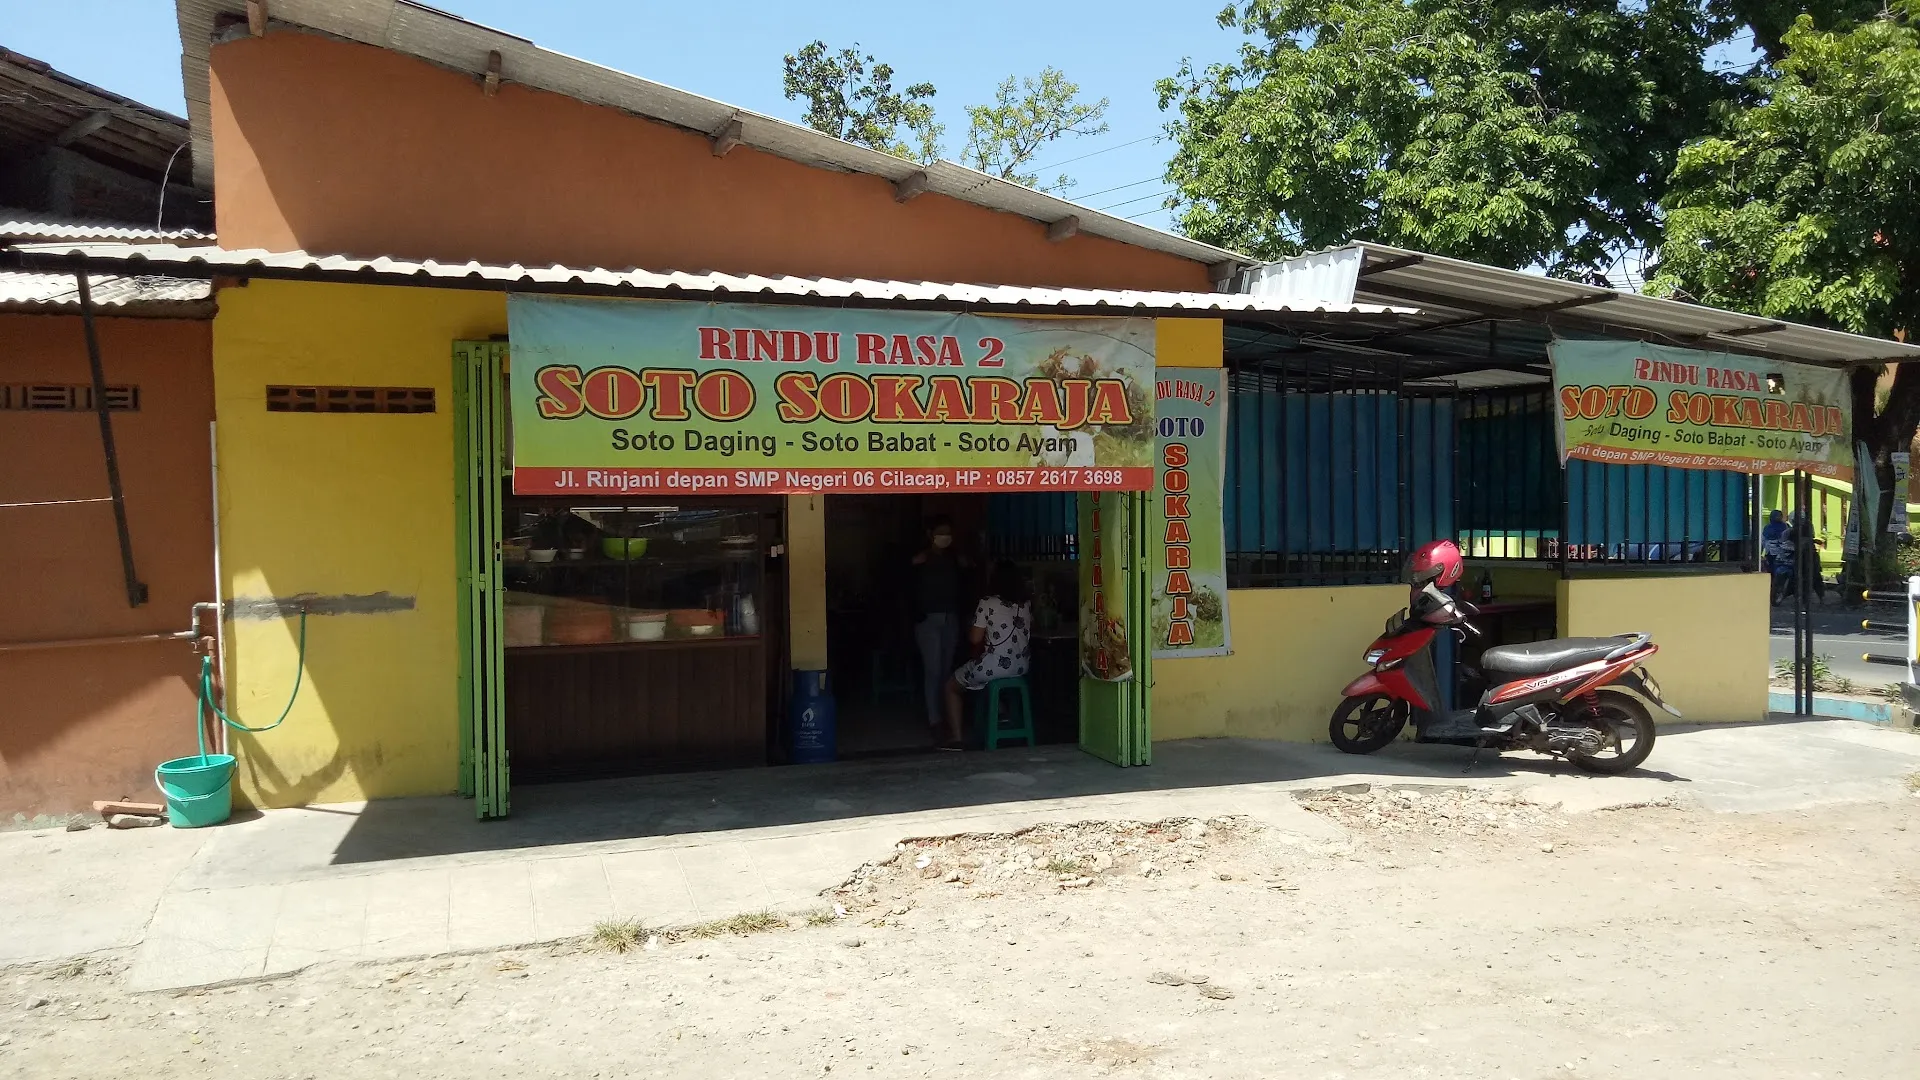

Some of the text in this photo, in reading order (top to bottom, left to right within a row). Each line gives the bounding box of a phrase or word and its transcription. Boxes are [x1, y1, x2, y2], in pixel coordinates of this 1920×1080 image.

[697, 326, 1005, 368] RINDU RASA 2
[1634, 358, 1761, 392] RINDU RASA
[535, 364, 1132, 431] SOTO SOKARAJA
[1175, 379, 1204, 403] RASA
[1203, 390, 1216, 407] 2
[1560, 384, 1843, 437] SOTO SOKARAJA
[612, 429, 674, 450] Soto
[685, 429, 776, 456] Daging
[801, 431, 859, 452] Soto
[868, 431, 937, 452] Babat
[958, 432, 1010, 452] Soto
[1016, 433, 1077, 456] Ayam
[1610, 422, 1661, 444] Daging
[1674, 429, 1704, 444] Soto
[1708, 432, 1745, 447] Babat
[1757, 435, 1787, 449] Soto
[1592, 447, 1627, 461] depan
[1630, 451, 1655, 461] SMP
[1655, 452, 1690, 465] Negeri
[1692, 456, 1705, 466] 06
[1752, 459, 1767, 470] HP
[555, 471, 579, 488] Jl.
[587, 471, 660, 491] Rinjani
[666, 471, 728, 491] depan
[734, 471, 779, 488] SMP
[786, 471, 847, 491] Negeri
[852, 471, 874, 487] 06
[880, 471, 950, 490] Cilacap,
[956, 472, 981, 486] HP
[996, 471, 1033, 486] 0857
[1040, 471, 1077, 486] 2617
[1083, 470, 1123, 486] 3698
[1163, 443, 1193, 646] SOKARAJA
